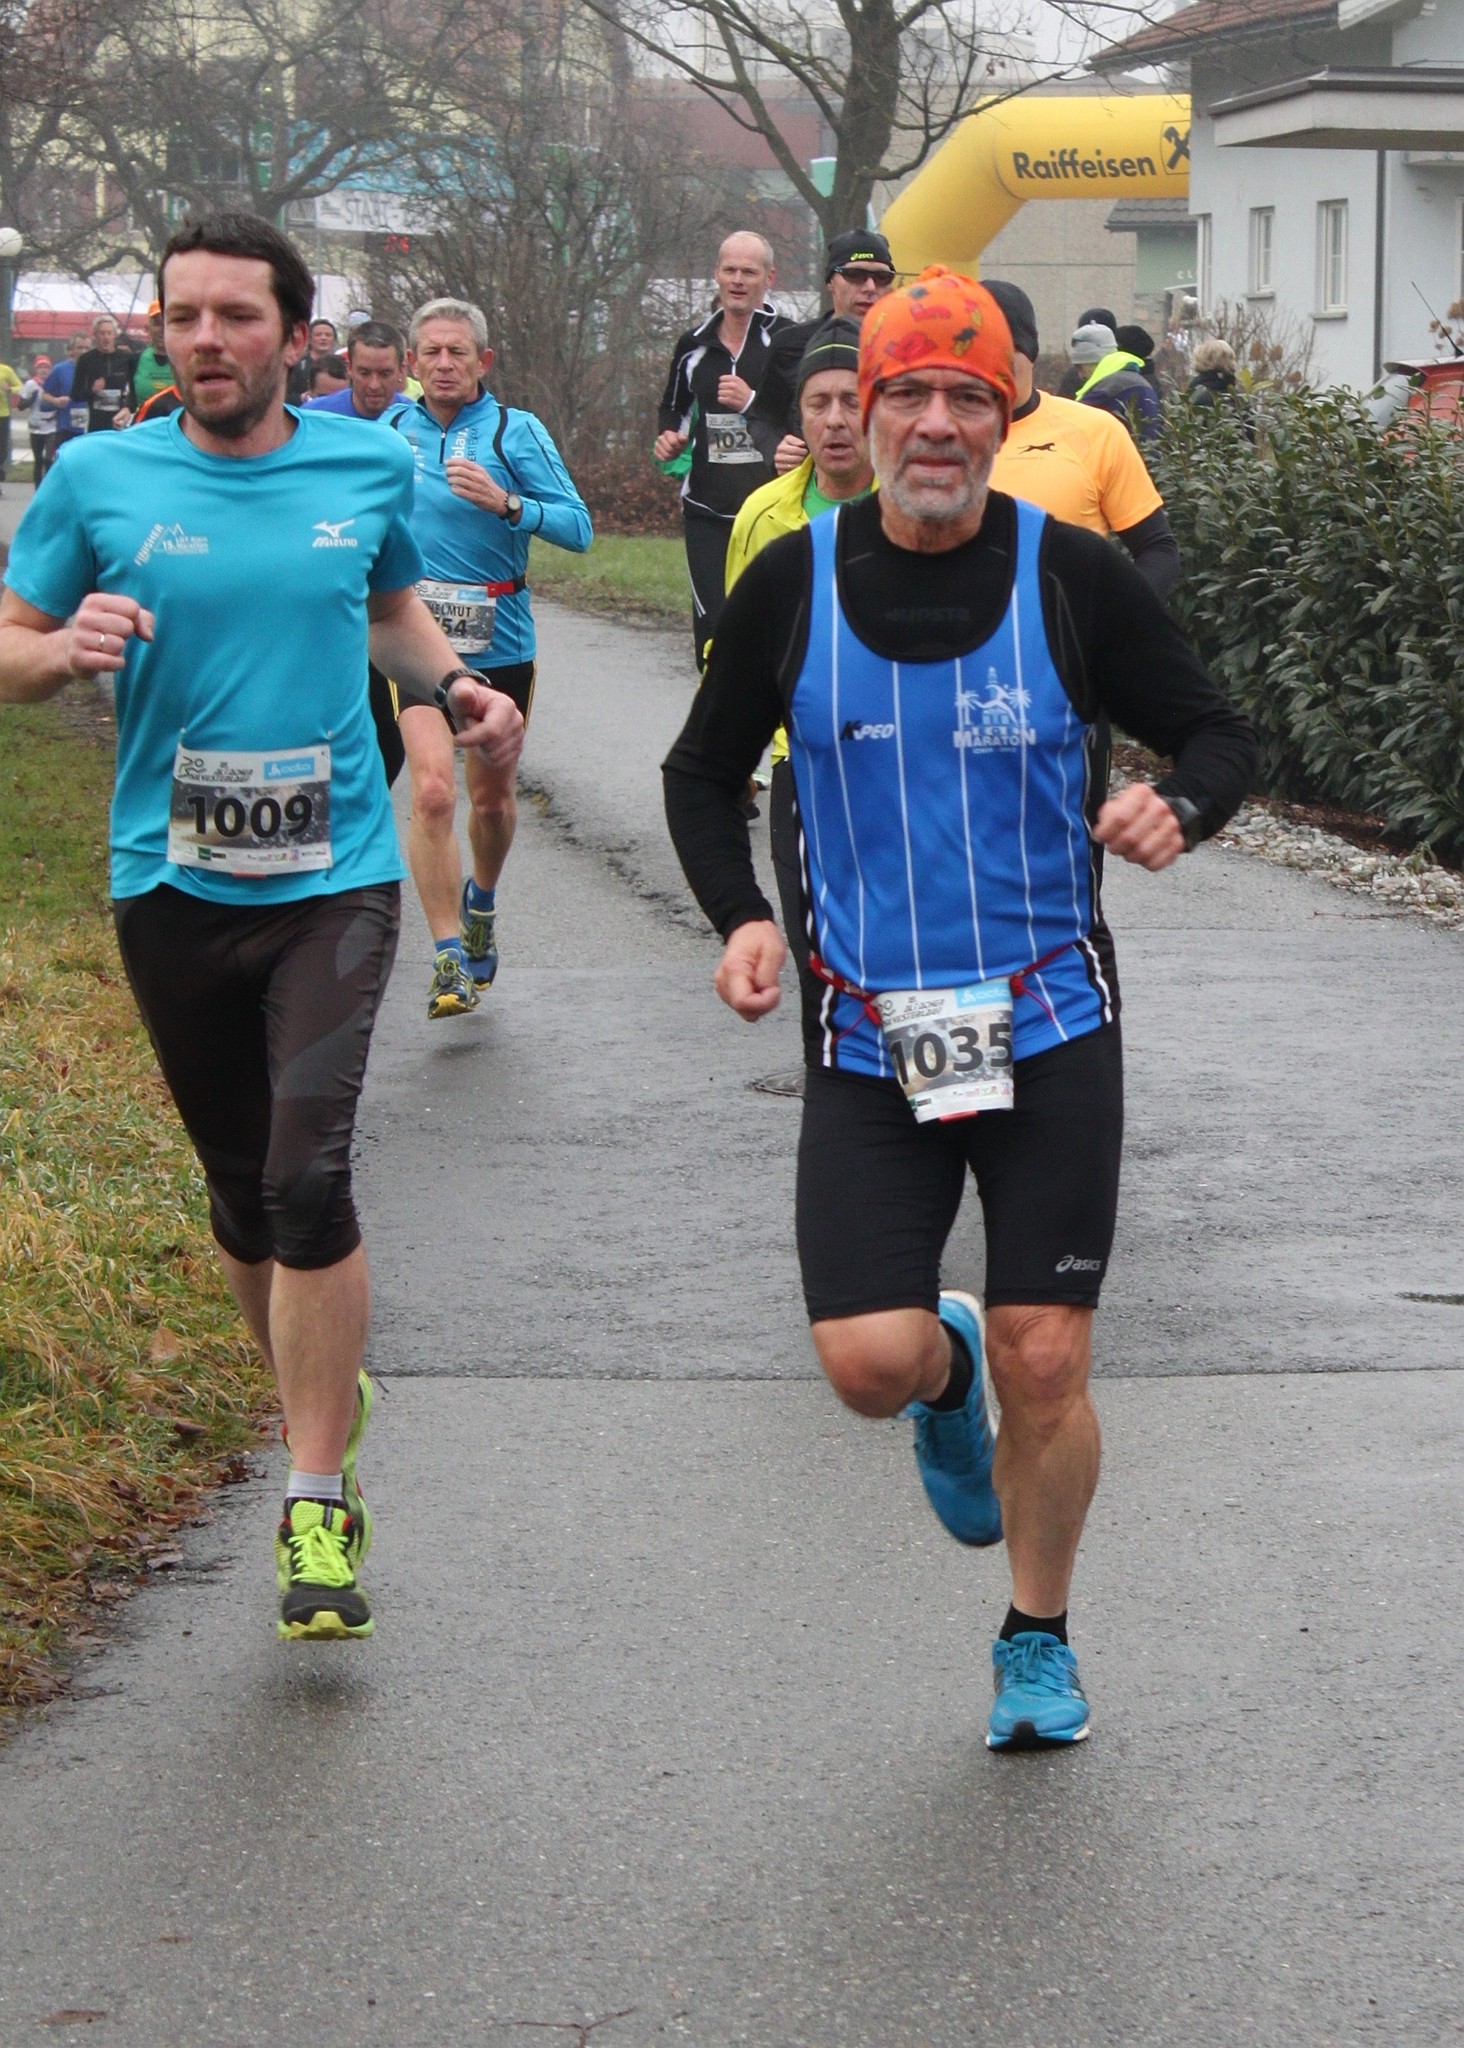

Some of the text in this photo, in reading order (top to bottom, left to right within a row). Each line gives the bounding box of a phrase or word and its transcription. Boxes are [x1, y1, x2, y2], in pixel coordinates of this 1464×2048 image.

[1012, 148, 1157, 179] Raiffeisen
[714, 431, 749, 449] 102
[187, 795, 313, 838] 1009
[890, 1022, 1013, 1085] 1035
